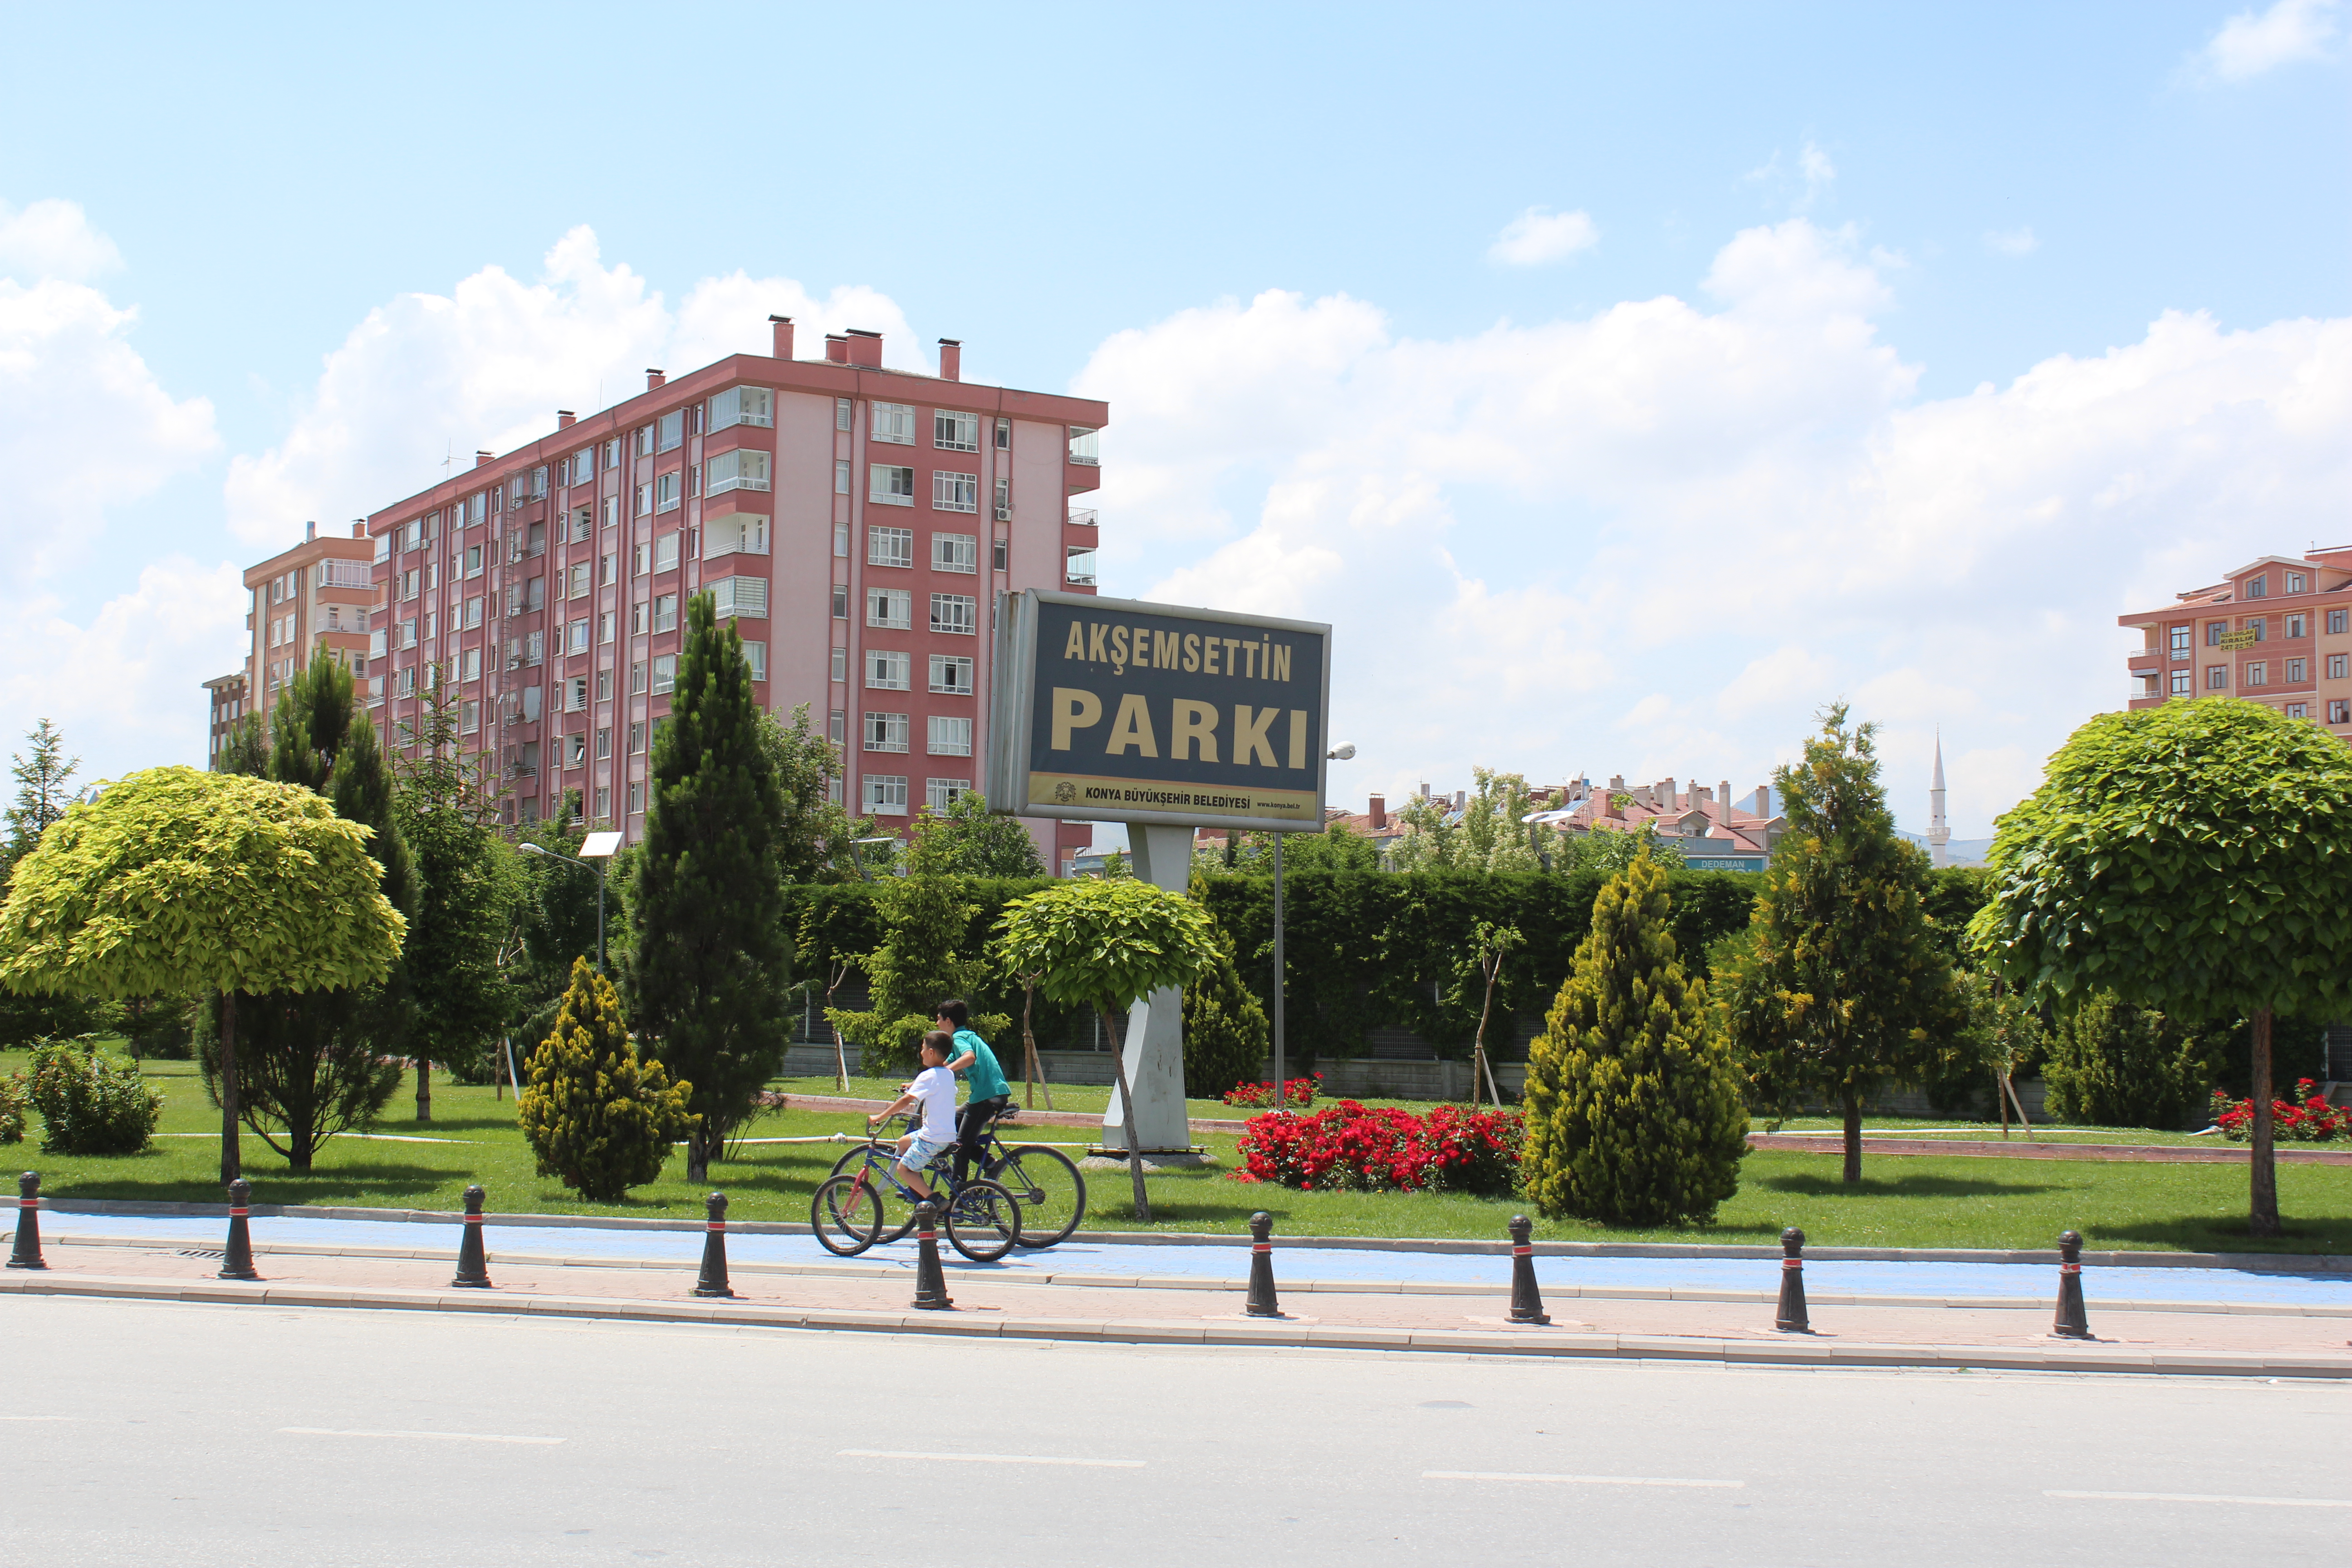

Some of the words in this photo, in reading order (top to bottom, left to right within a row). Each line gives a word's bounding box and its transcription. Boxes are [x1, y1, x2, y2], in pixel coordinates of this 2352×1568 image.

[1064, 621, 1291, 682] AKŞEMSETTİN
[1051, 686, 1307, 770] PARKI
[1085, 787, 1121, 800] KONYA
[1124, 788, 1191, 806] BÜYÜKŞEHİR
[1193, 794, 1250, 809] BELEDİYESİ
